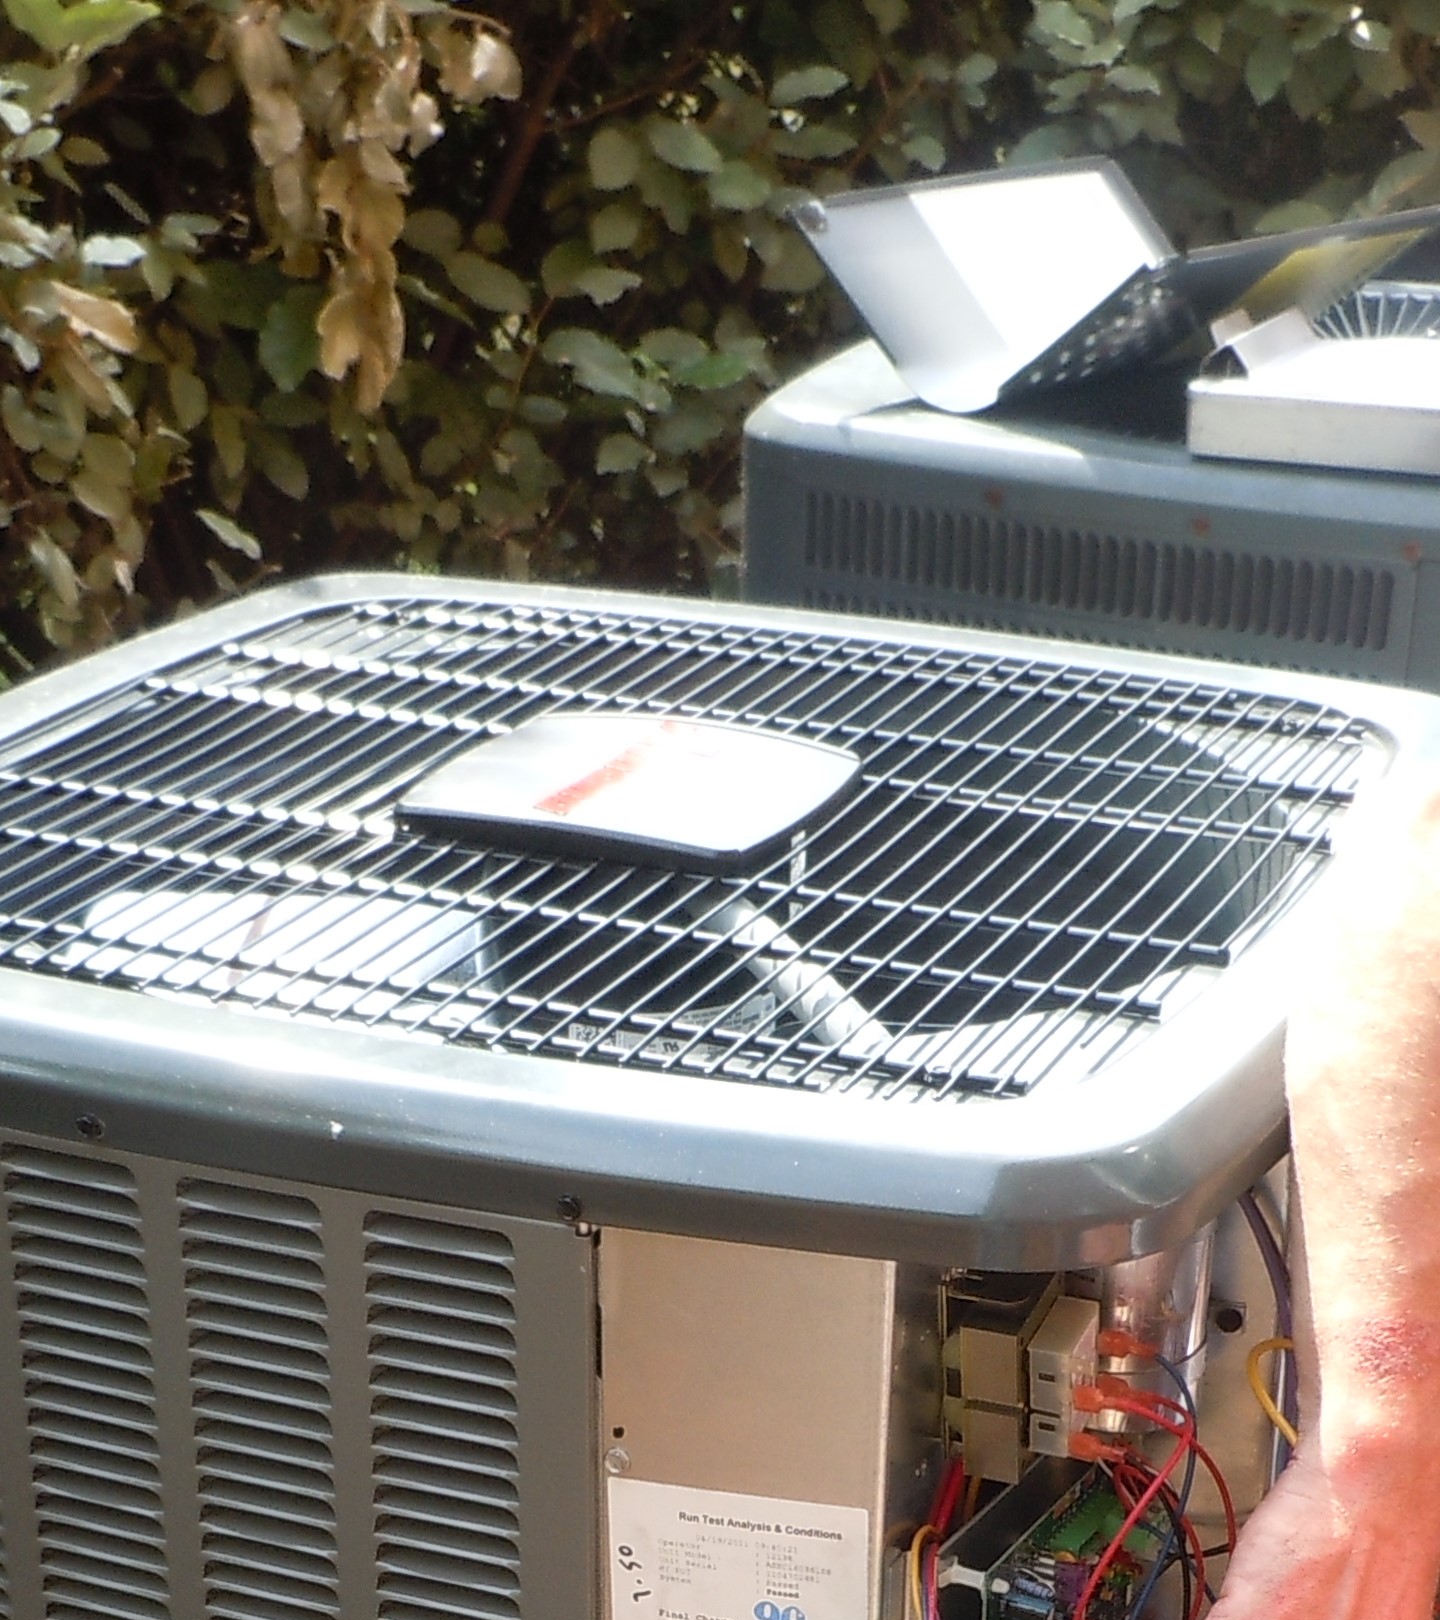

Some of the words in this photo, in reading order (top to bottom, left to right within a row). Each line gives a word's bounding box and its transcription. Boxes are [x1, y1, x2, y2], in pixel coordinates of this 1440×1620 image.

[679, 1511, 700, 1523] Run
[702, 1514, 725, 1527] Test
[727, 1518, 772, 1533] Analysis
[774, 1524, 782, 1533] &
[785, 1525, 843, 1541] Conditions
[766, 1588, 800, 1600] Passed
[659, 1609, 690, 1620] Final
